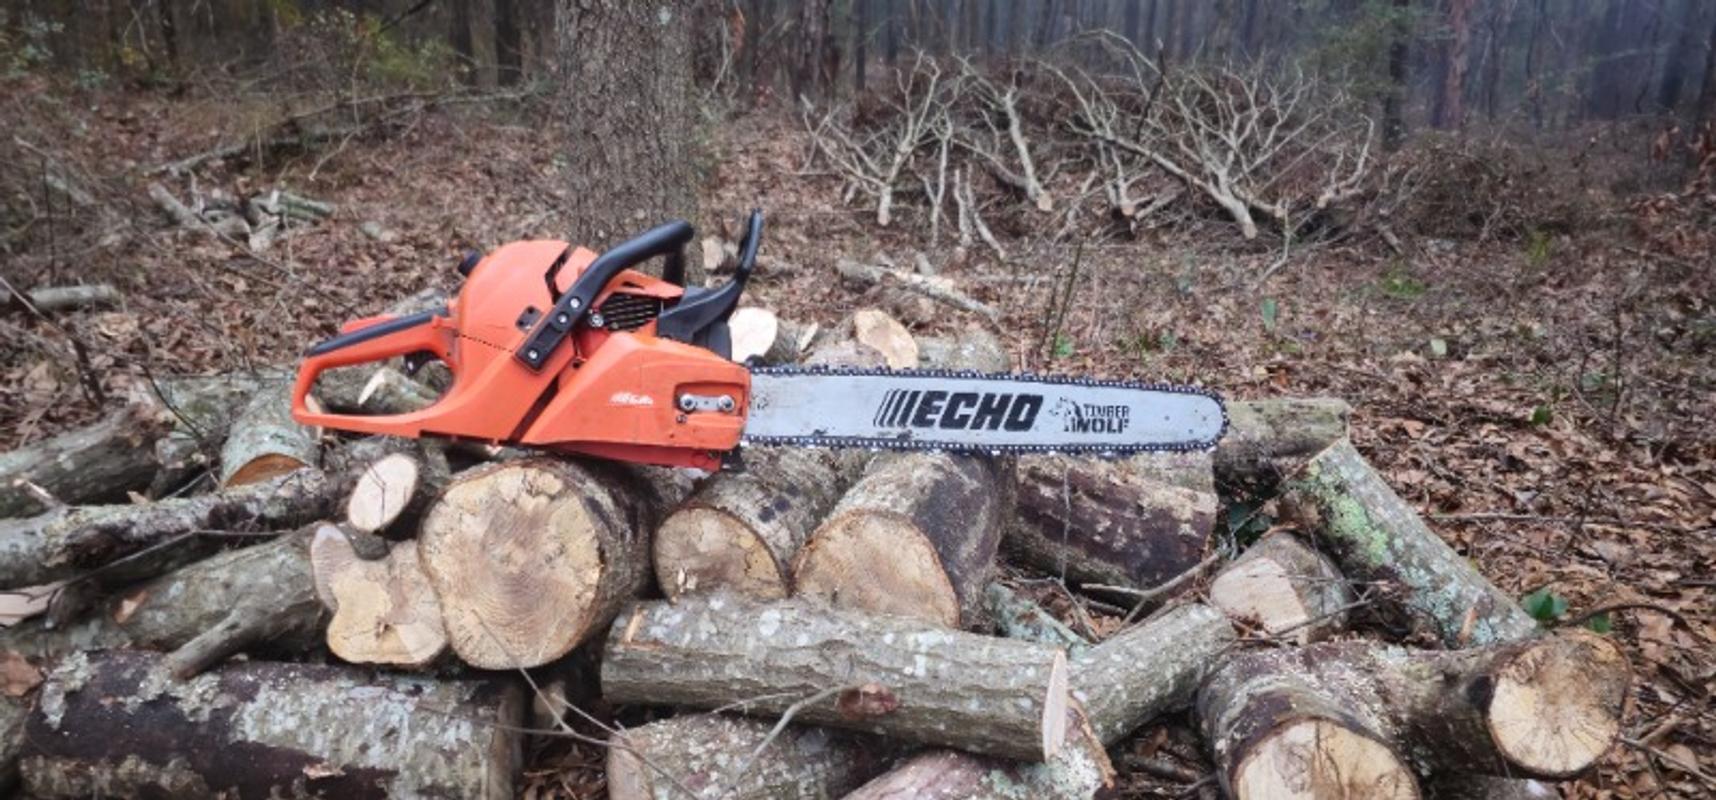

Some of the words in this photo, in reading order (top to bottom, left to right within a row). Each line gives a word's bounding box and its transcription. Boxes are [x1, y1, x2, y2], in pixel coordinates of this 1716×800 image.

[911, 390, 1044, 432] ECHO
[1083, 403, 1130, 418] TIMBER
[1071, 418, 1130, 434] WOLF
